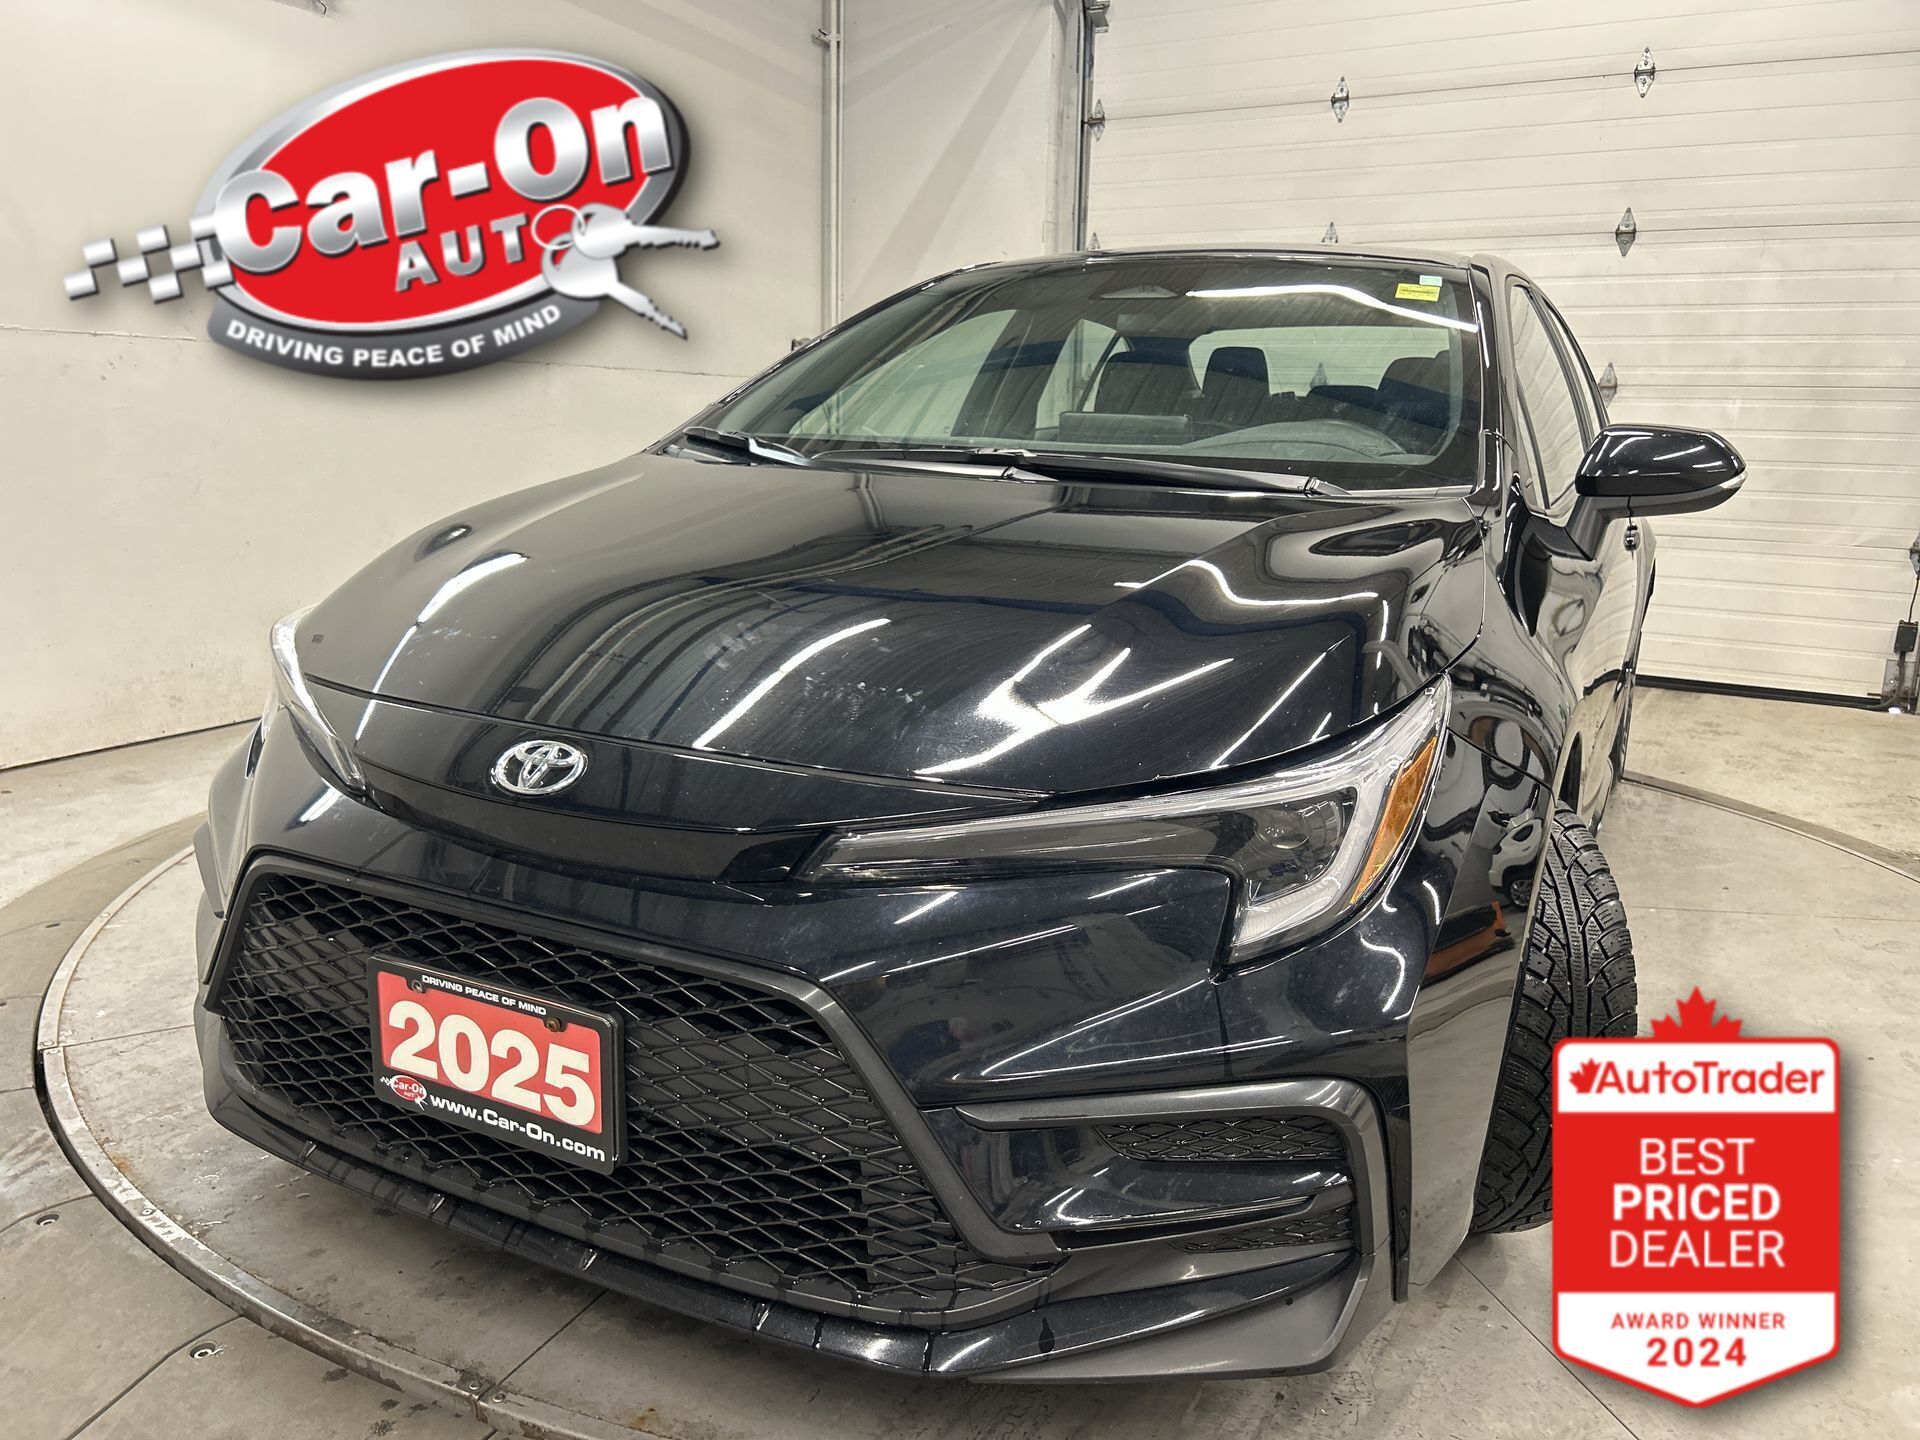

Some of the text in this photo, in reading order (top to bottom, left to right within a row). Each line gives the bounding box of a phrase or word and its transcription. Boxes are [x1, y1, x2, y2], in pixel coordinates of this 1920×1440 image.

[422, 975, 546, 1016] DRIVING PEACE OF MIND
[388, 1000, 595, 1126] 2025
[391, 1079, 424, 1094] Car-On
[430, 1095, 606, 1162] www.Car-On.com
